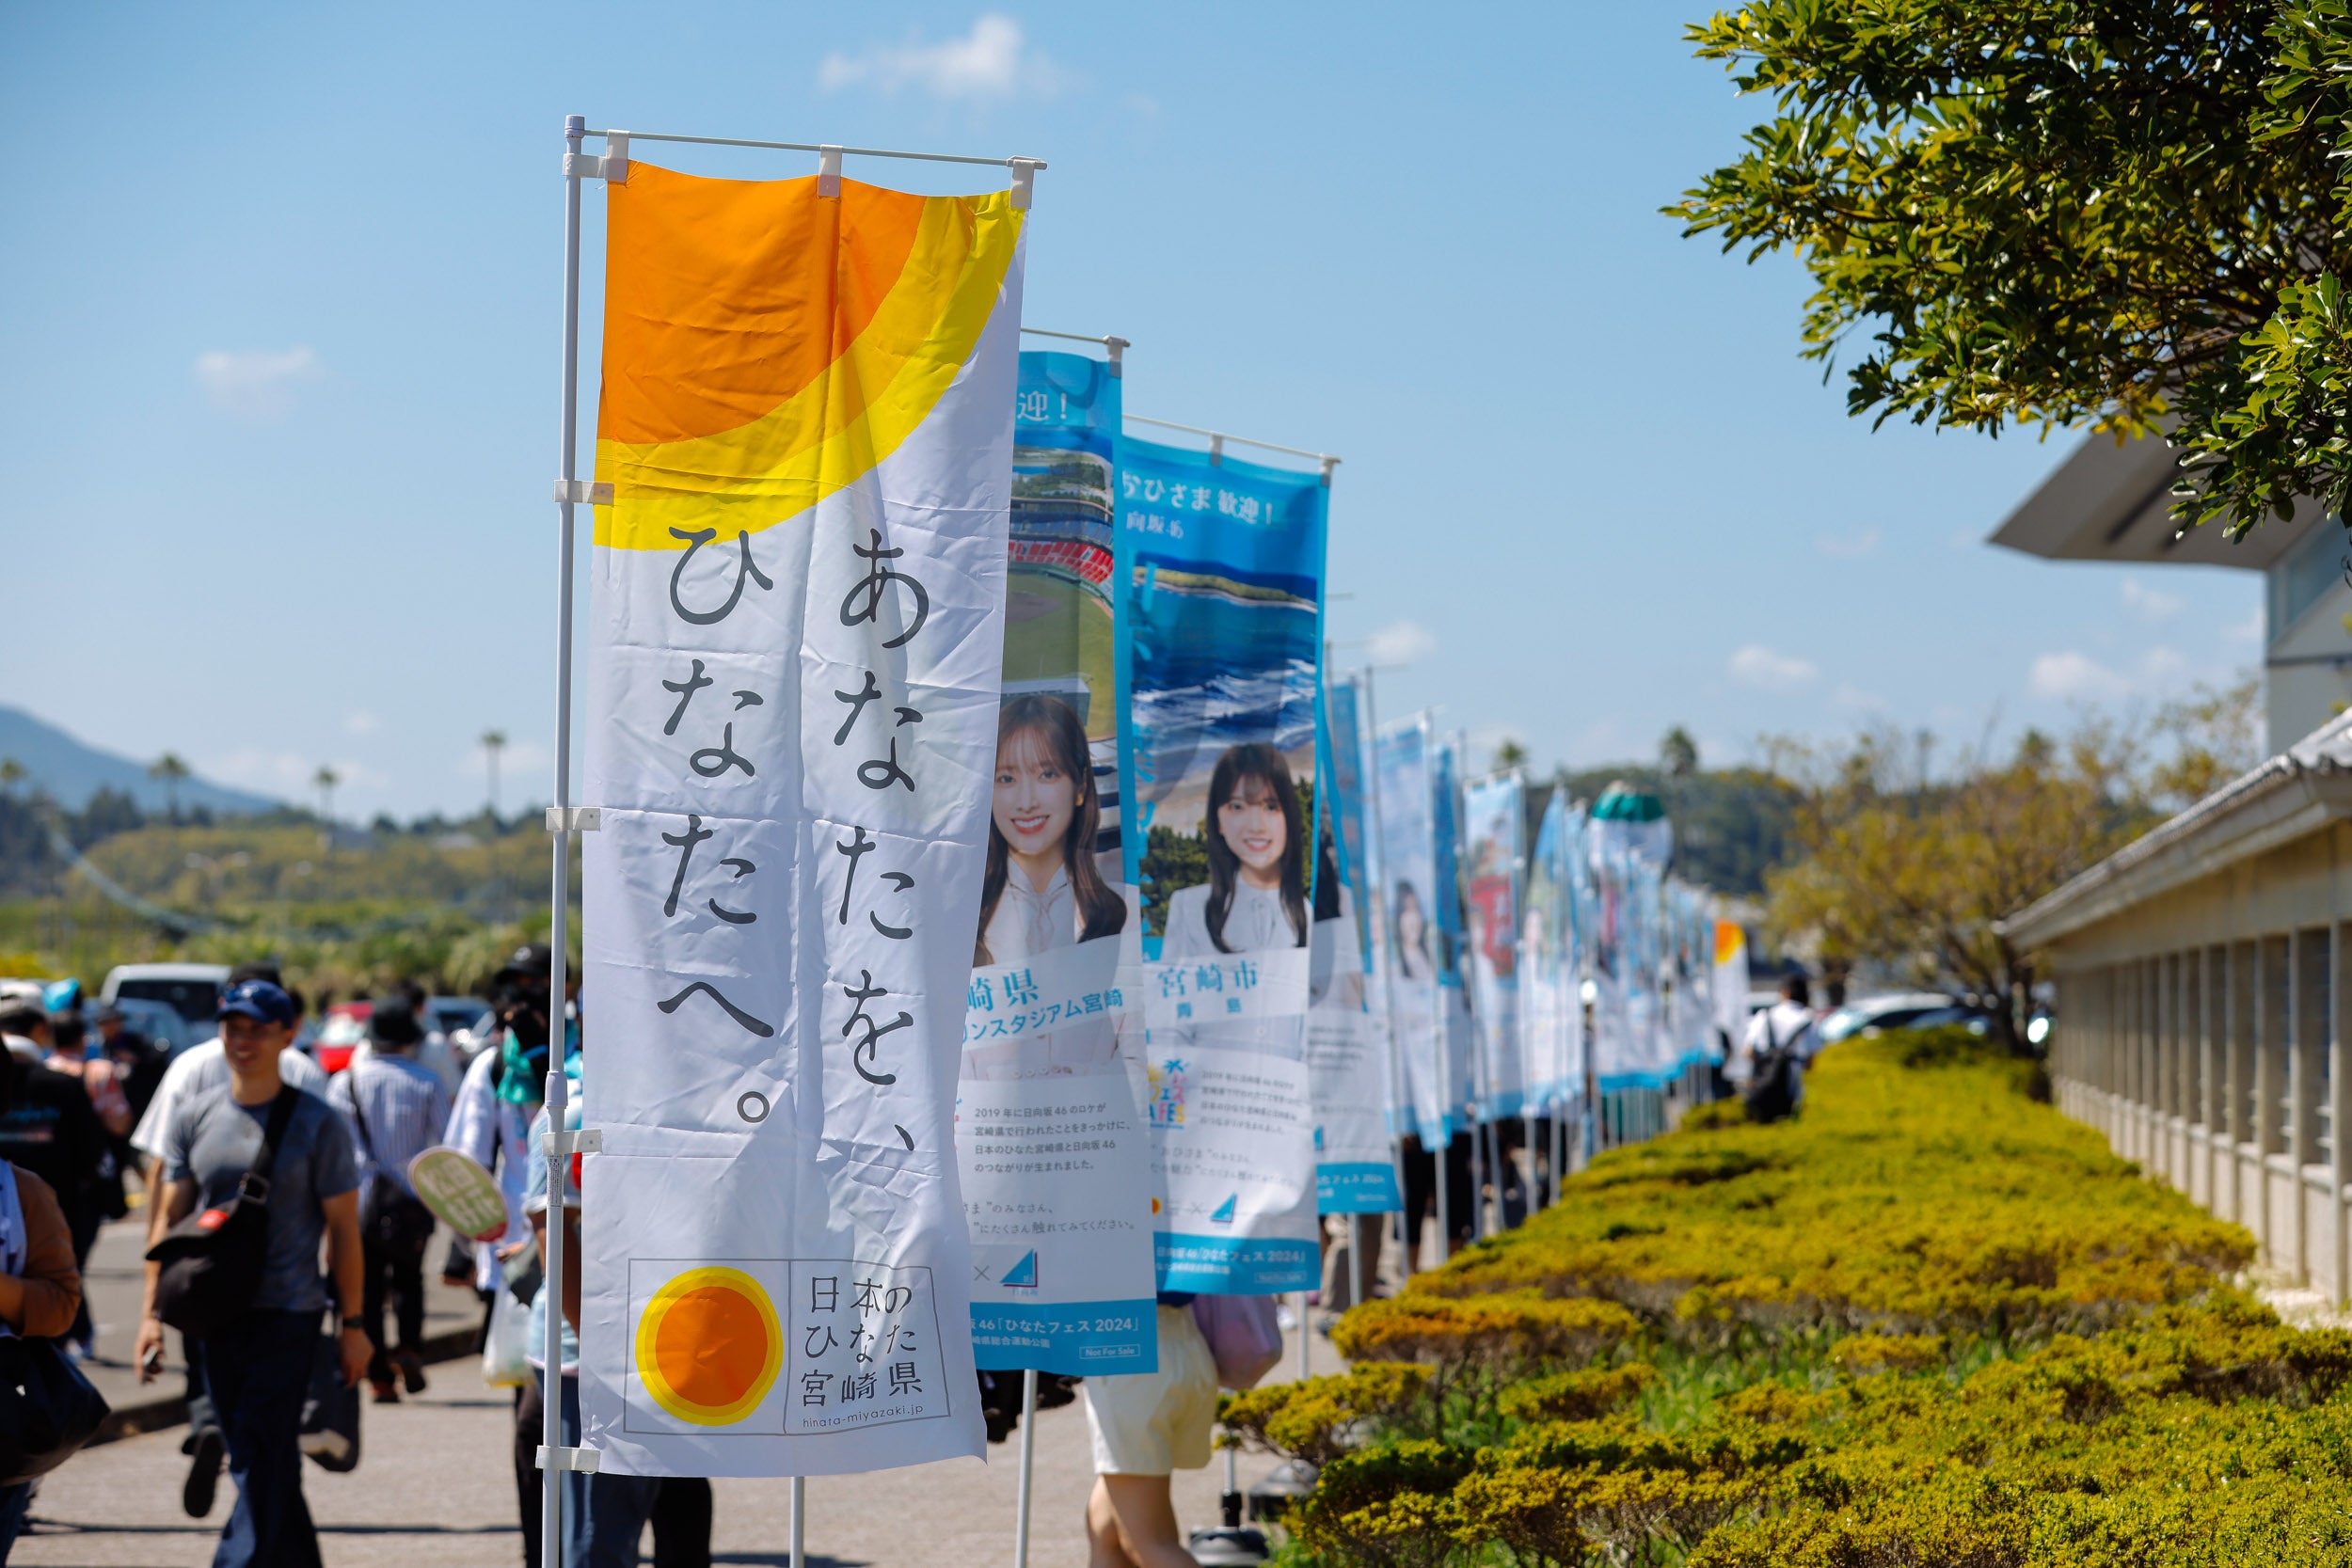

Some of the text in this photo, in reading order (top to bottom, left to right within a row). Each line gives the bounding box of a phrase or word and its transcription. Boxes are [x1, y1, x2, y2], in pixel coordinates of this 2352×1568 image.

[658, 526, 774, 1123] ひなたへ。
[834, 528, 930, 1150] あなたを、
[812, 1276, 913, 1318] 日本の
[805, 1323, 917, 1363] ひなた
[801, 1362, 923, 1407] 宮崎県
[803, 1404, 924, 1428] hinata-miyazaki.jp
